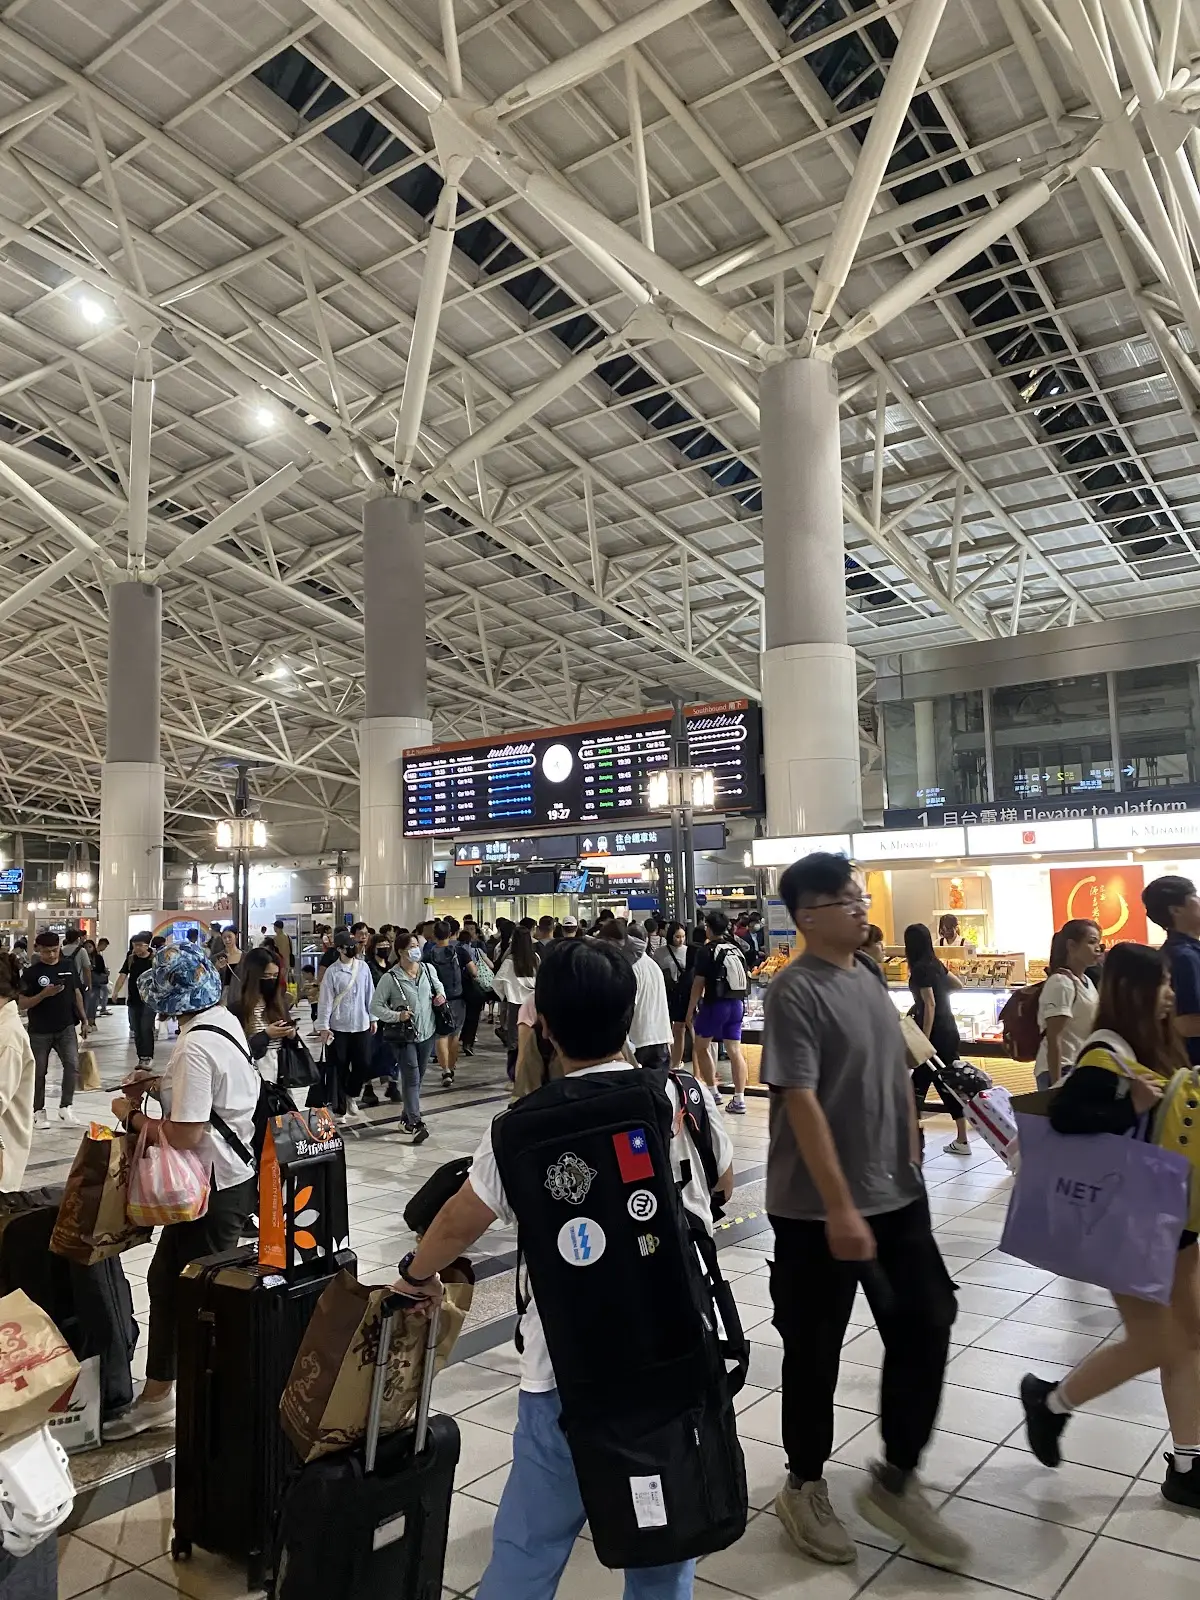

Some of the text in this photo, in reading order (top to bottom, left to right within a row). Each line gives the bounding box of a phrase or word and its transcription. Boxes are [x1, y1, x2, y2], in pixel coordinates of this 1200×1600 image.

[692, 700, 742, 715] Southbound 南下
[546, 808, 570, 820] 19:27
[918, 812, 928, 827] 1
[1024, 806, 1088, 821] Elevator
[1092, 805, 1108, 818] to
[1114, 800, 1187, 816] platform
[488, 880, 505, 890] 1-6
[319, 903, 324, 912] 3
[1056, 1177, 1103, 1203] NET
